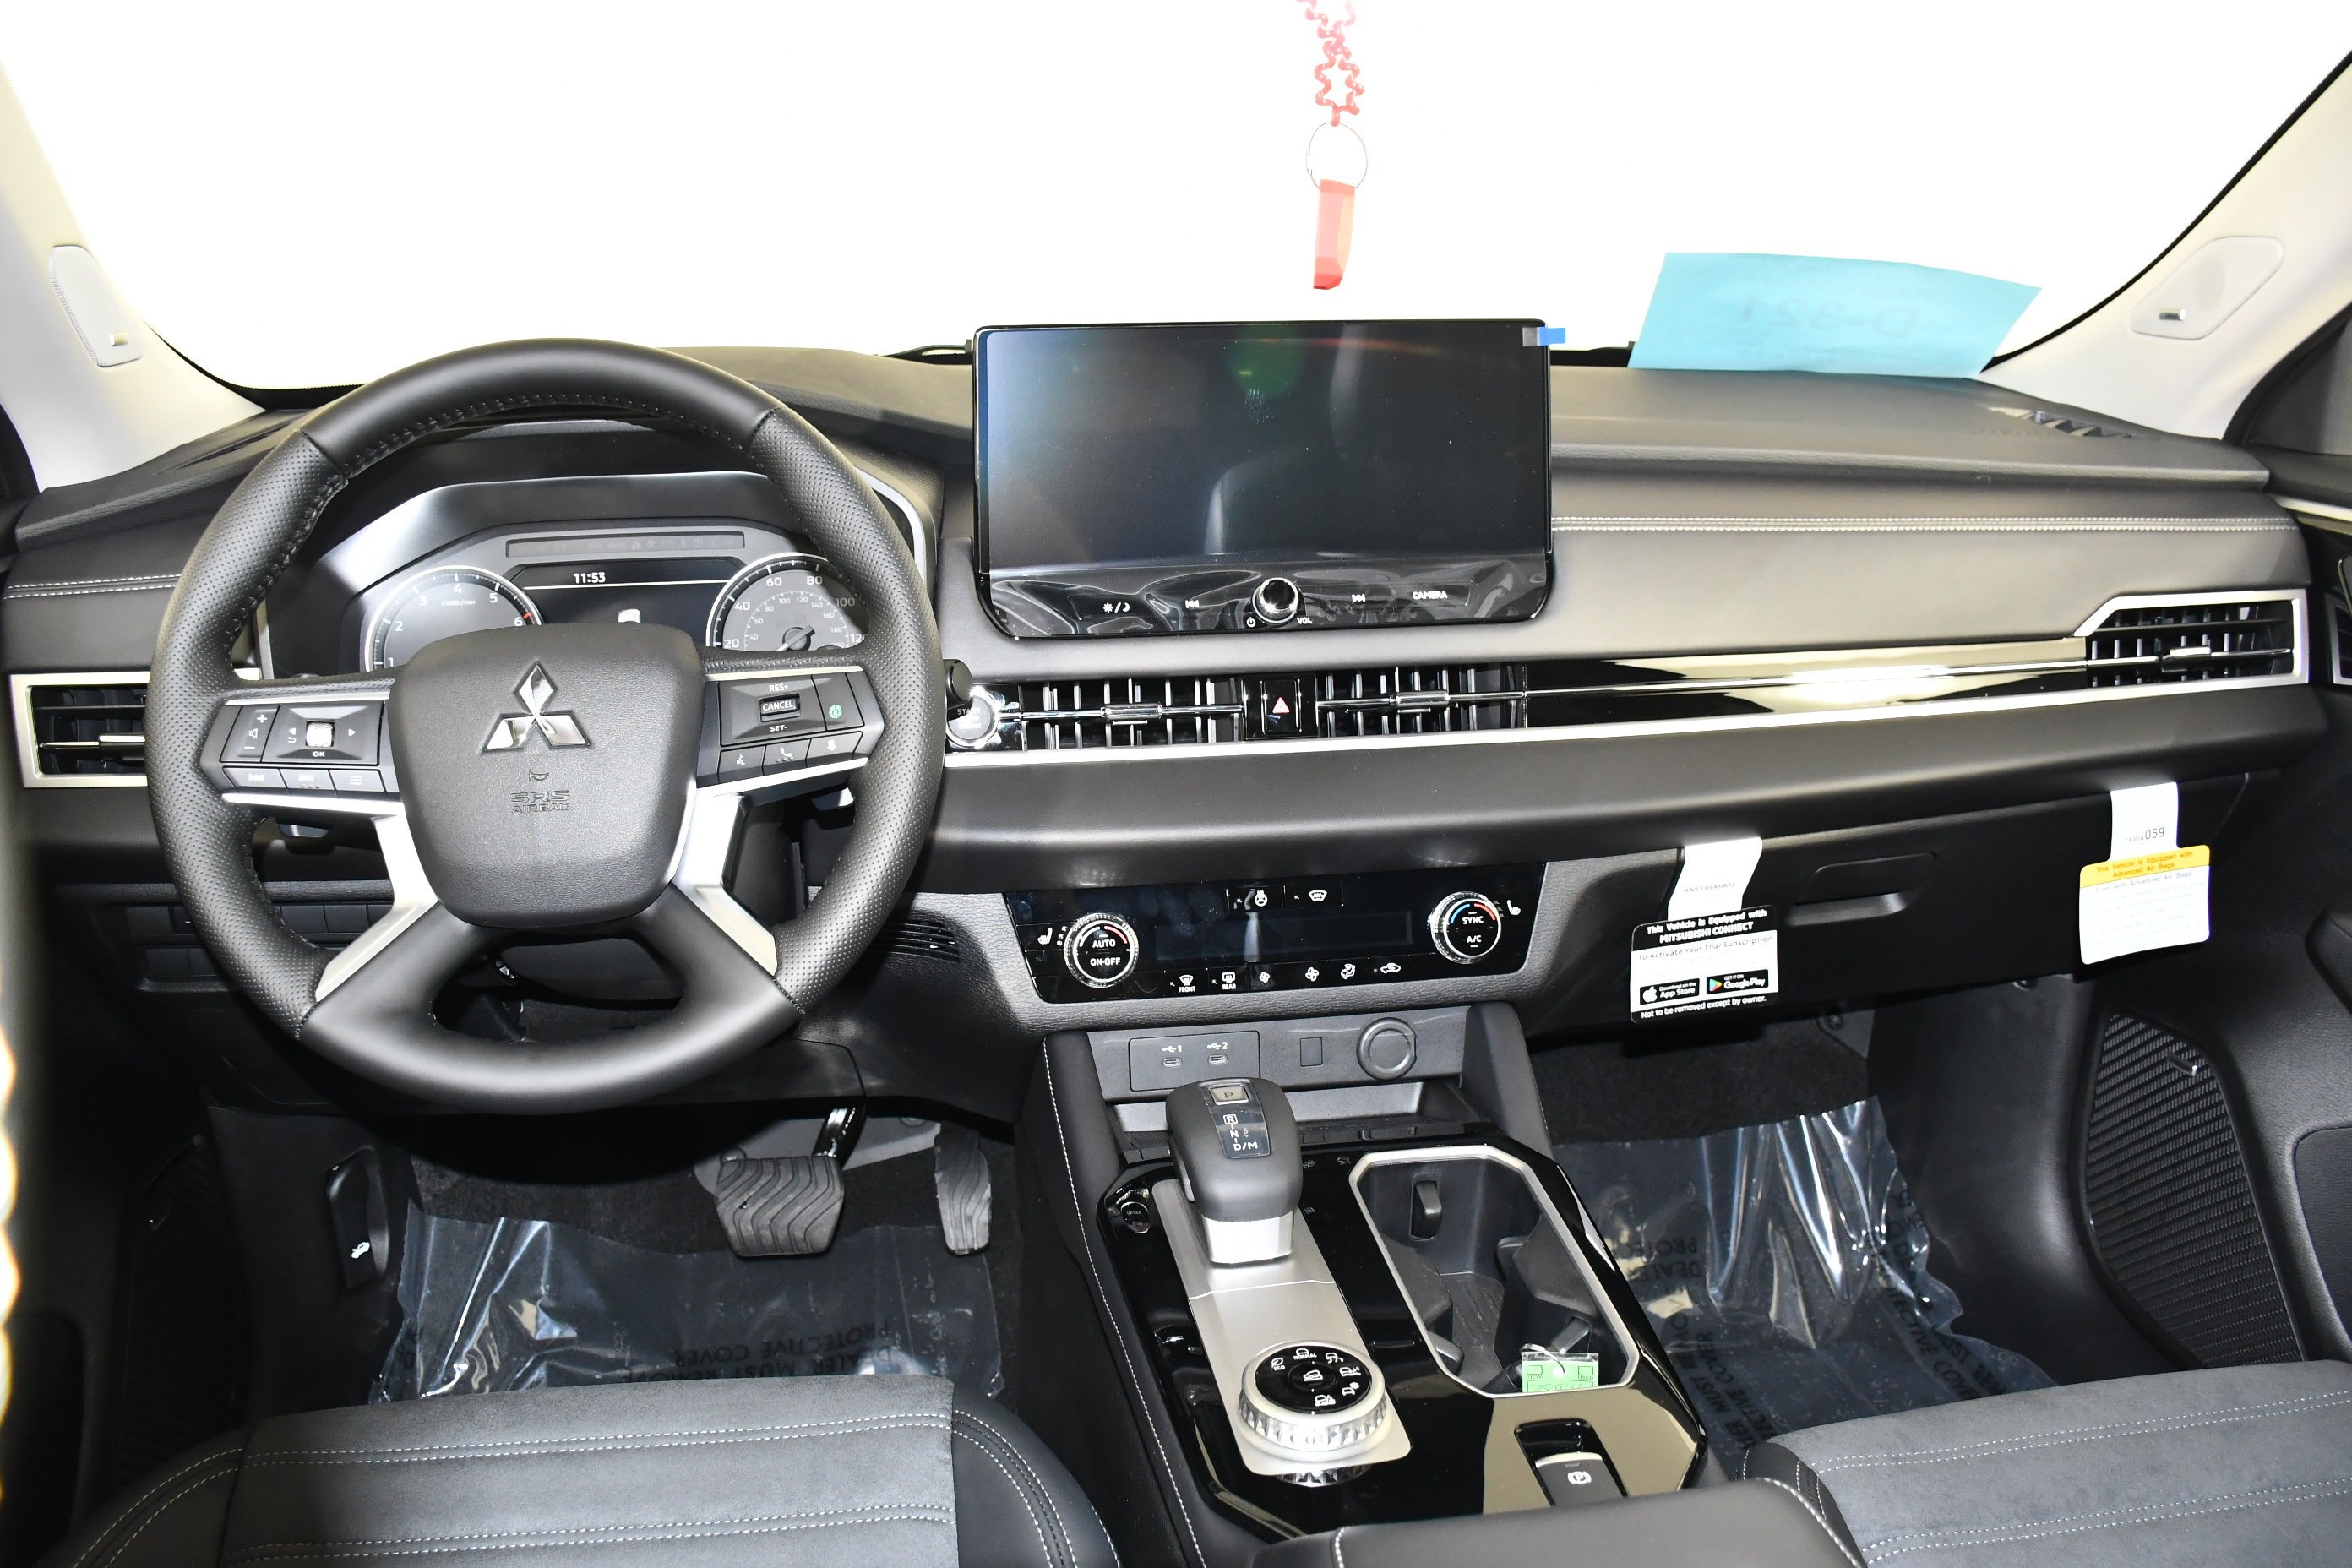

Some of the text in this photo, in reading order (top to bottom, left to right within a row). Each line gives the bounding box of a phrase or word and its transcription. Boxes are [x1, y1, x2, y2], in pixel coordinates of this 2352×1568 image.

[574, 571, 607, 585] 11:53
[765, 576, 783, 587] 60
[806, 575, 823, 585] 80
[453, 585, 463, 595] 4
[419, 594, 428, 606] 3
[489, 593, 499, 604] 5
[1412, 591, 1448, 601] CAMERA
[734, 601, 751, 611] 40
[836, 597, 856, 607] 100
[514, 616, 524, 626] 6
[1296, 616, 1313, 625] VOL
[395, 621, 404, 632] 2
[724, 638, 741, 649] 20
[769, 683, 789, 693] RES+
[762, 700, 794, 711] CANCEL
[770, 724, 788, 732] SET-
[509, 790, 570, 804] SRS
[511, 802, 570, 814] AIRBAG
[2113, 860, 2135, 870] Vehicle
[2147, 853, 2176, 865] Equipped
[2113, 867, 2143, 878] Advanced
[2159, 862, 2175, 871] Bags
[1462, 915, 1484, 925] SYNC
[1647, 908, 1767, 934] This Vehicle is Equipped with
[1659, 921, 1755, 944] MITSUBISHI CONNECT
[1092, 939, 1116, 949] AUTO
[1466, 934, 1482, 944] A/C
[1650, 948, 1683, 959] Activate
[1685, 945, 1702, 954] Your
[1704, 943, 1722, 951] Trial
[1723, 935, 1773, 948] Subscription
[1723, 977, 1766, 989] Google Play
[1179, 985, 1196, 994] FRONT
[1659, 987, 1696, 999] App Store
[1642, 1010, 1654, 1019] Not
[1655, 1008, 1663, 1016] to
[1674, 1000, 1706, 1013] removed
[1707, 997, 1731, 1010] except
[1731, 997, 1741, 1006] by
[1742, 995, 1767, 1004] owner.
[1177, 1044, 1183, 1053] 1
[1222, 1041, 1228, 1050] 2
[1226, 1115, 1235, 1124] R
[1229, 1129, 1239, 1139] N
[1233, 1141, 1258, 1152] D/M
[673, 1344, 750, 1369] COVER
[1933, 1360, 1979, 1401] COVE
